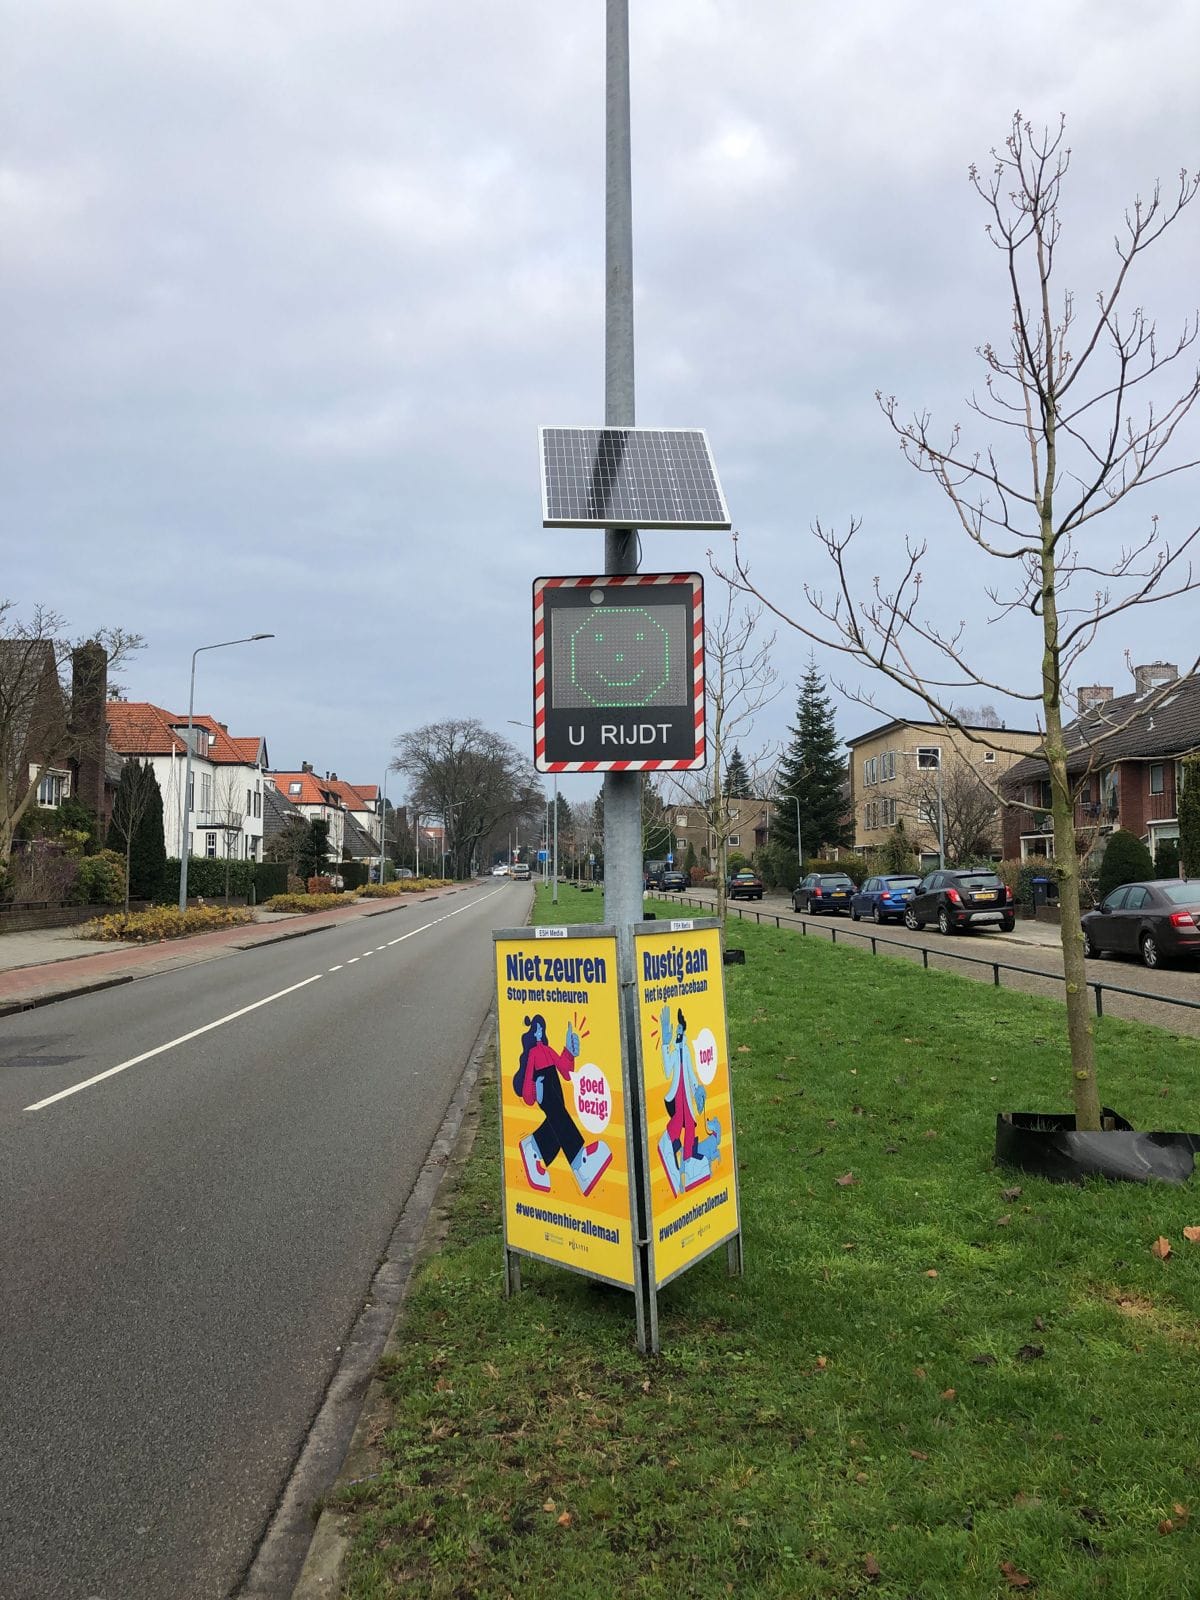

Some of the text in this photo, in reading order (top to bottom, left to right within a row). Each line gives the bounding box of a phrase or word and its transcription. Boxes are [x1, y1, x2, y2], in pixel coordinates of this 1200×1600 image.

[568, 723, 673, 746] U RIJDT
[506, 951, 607, 984] Niet zeuren
[643, 945, 708, 983] Rustig aan
[507, 986, 589, 1004] Stop met scheuren
[644, 979, 708, 1004] Het is geen racebaan
[699, 1045, 714, 1066] top!
[580, 1075, 605, 1096] goed
[578, 1095, 609, 1121] bezig!
